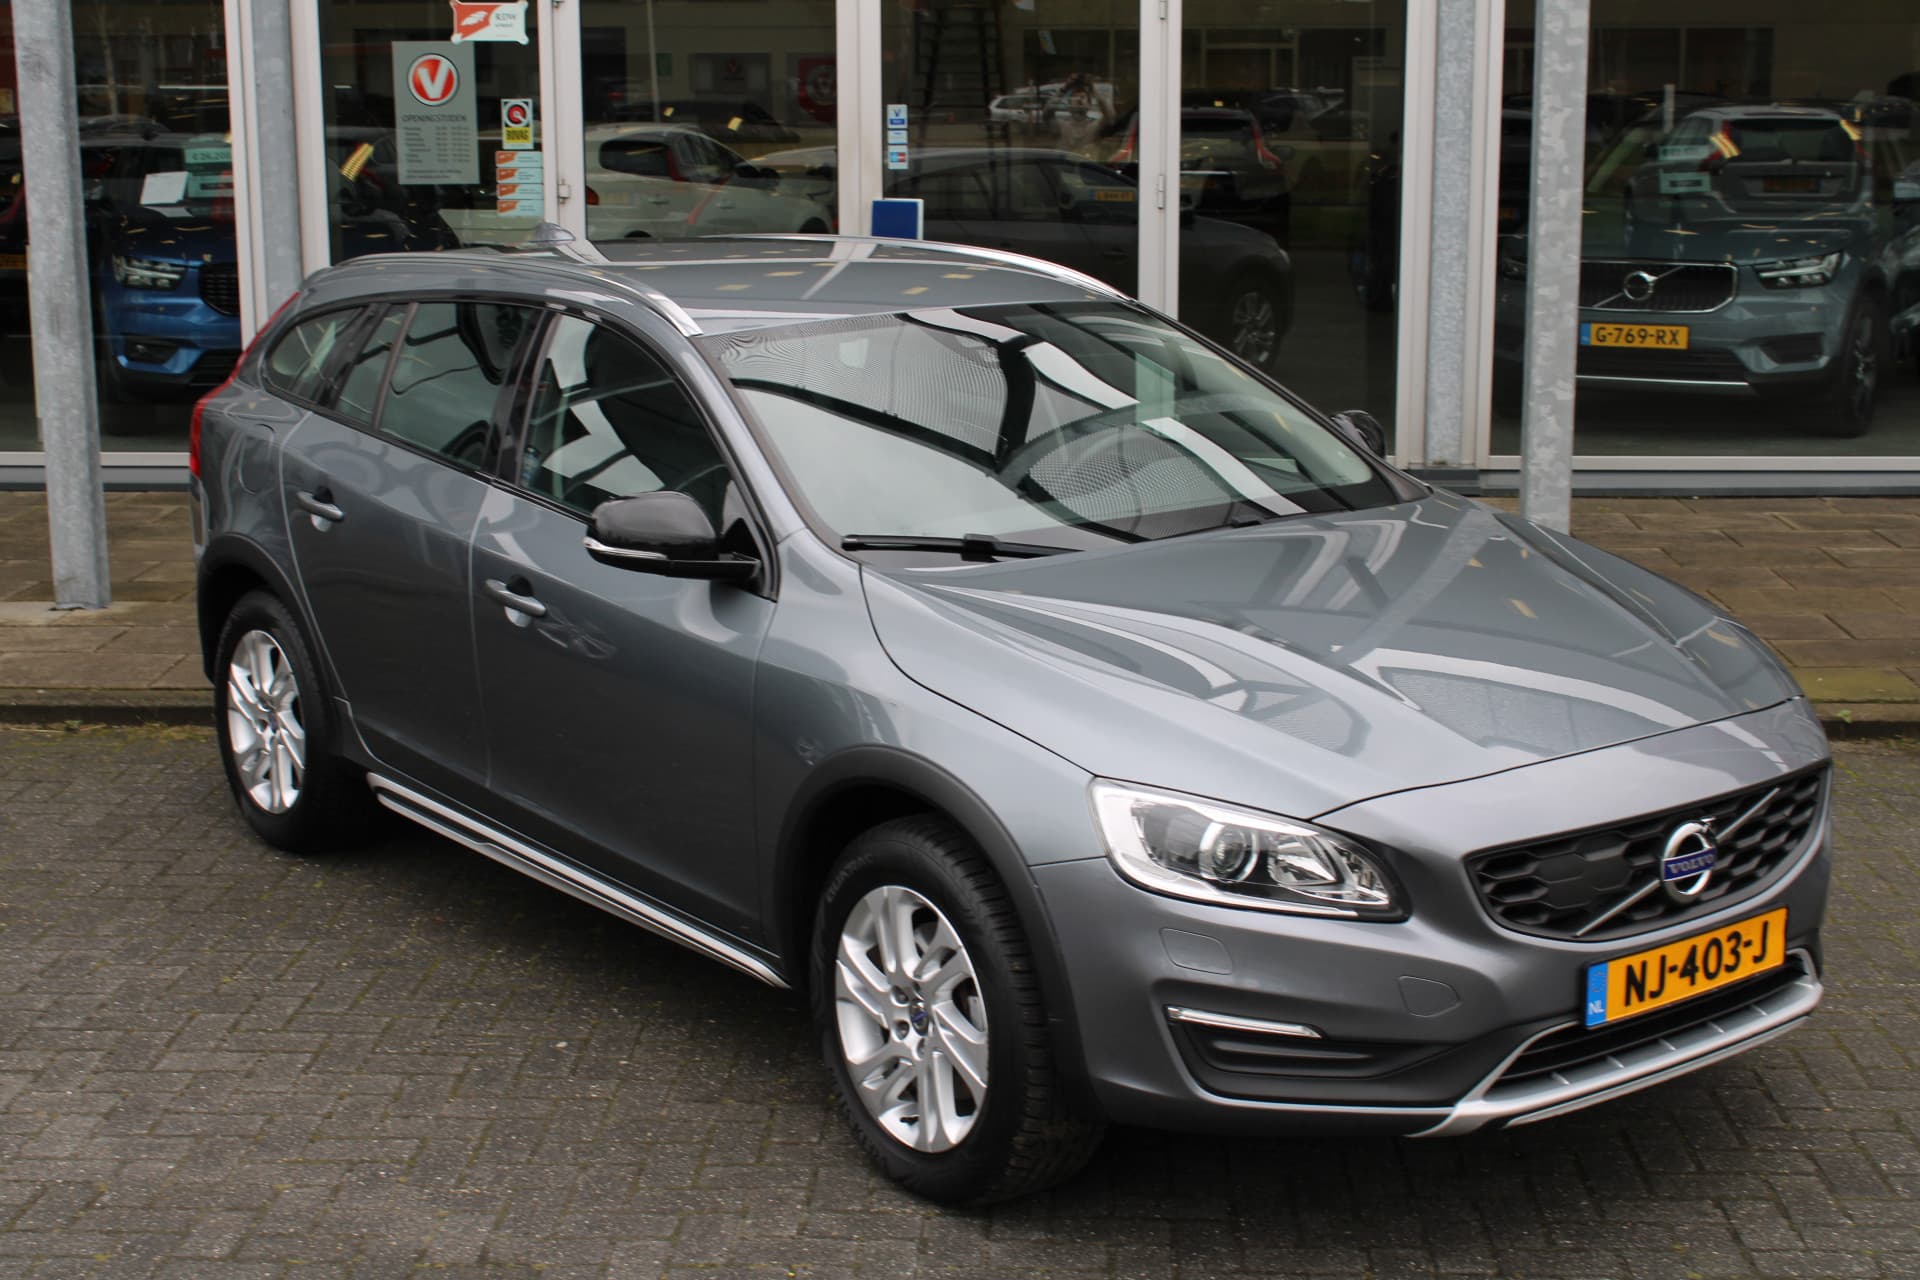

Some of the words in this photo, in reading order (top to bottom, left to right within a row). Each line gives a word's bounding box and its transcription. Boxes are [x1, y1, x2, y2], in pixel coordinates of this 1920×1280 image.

[417, 60, 449, 98] V
[1596, 327, 1680, 345] G-769-RX
[1667, 853, 1714, 874] VOLVO
[1623, 920, 1769, 1007] NJ-403-J
[1588, 1000, 1605, 1015] NL
